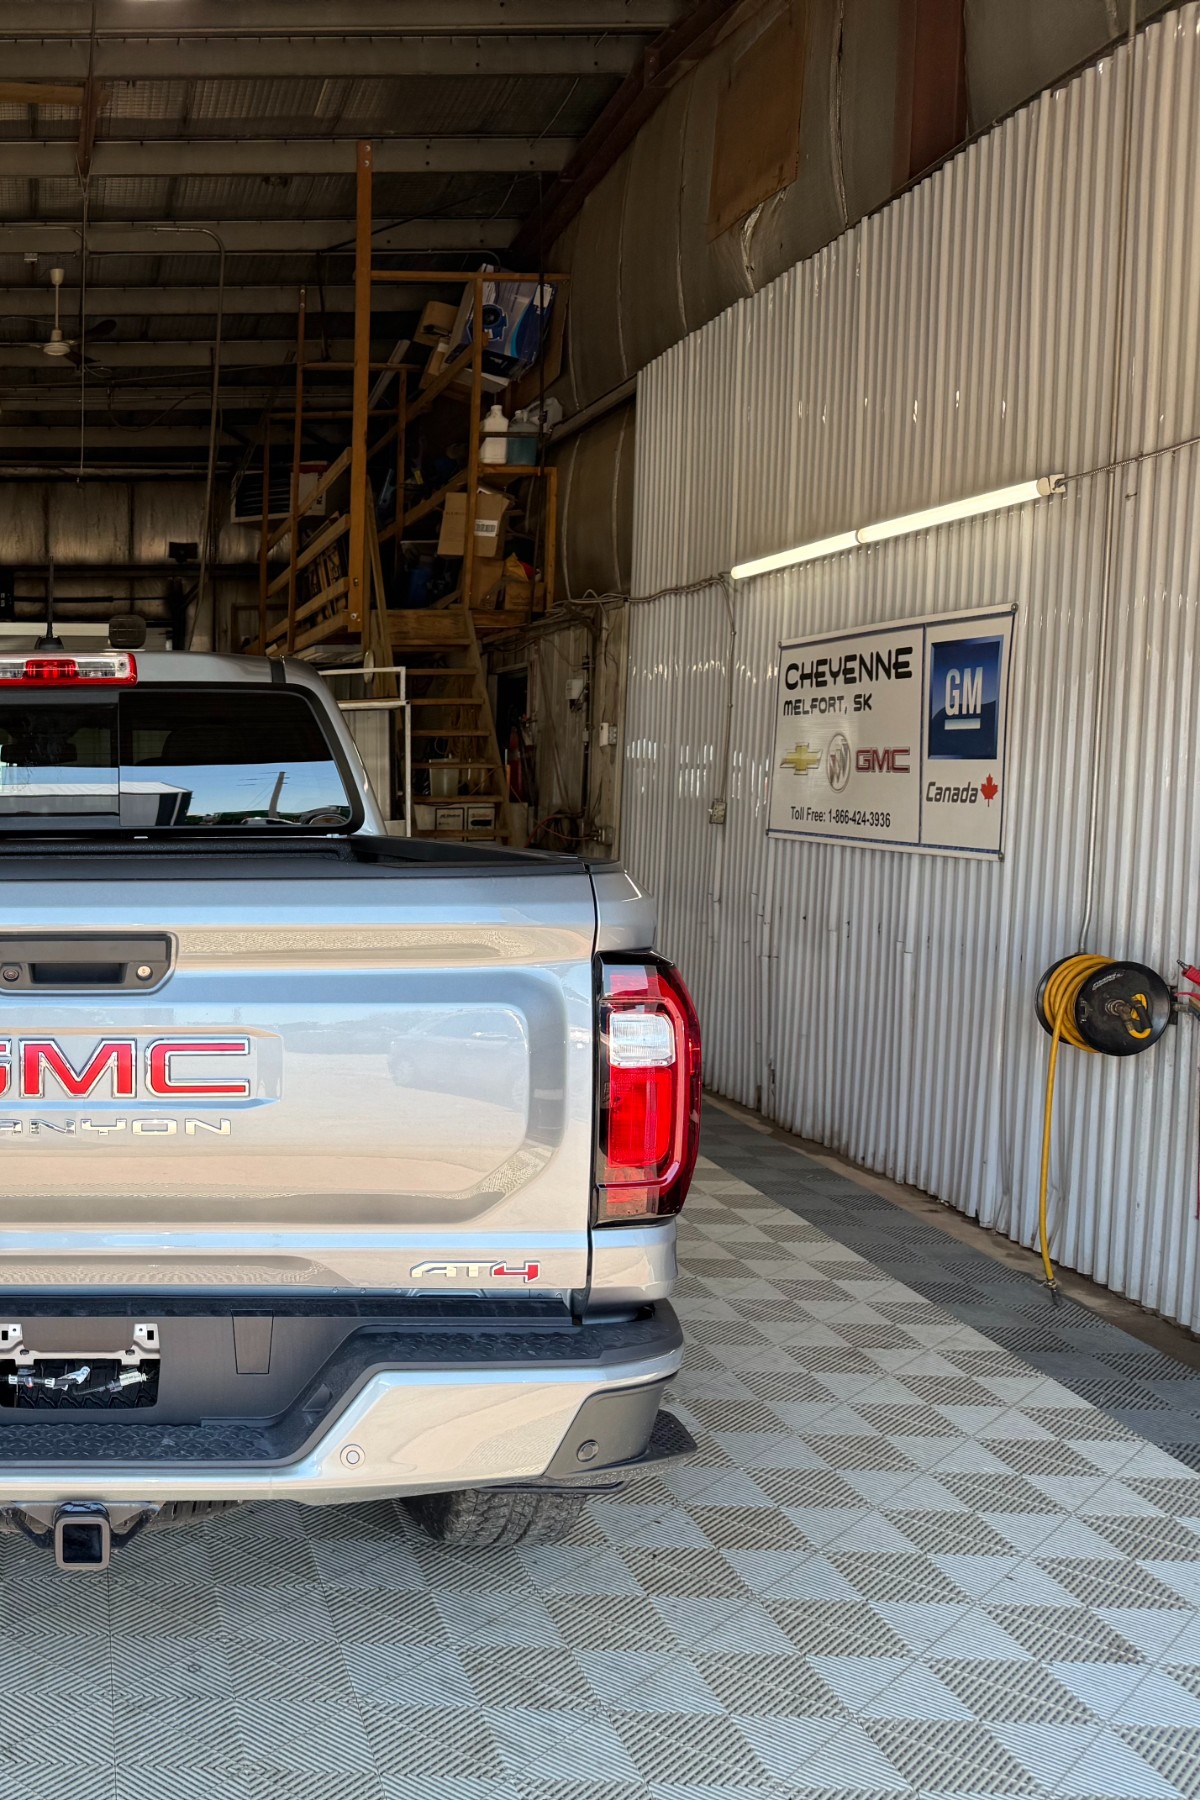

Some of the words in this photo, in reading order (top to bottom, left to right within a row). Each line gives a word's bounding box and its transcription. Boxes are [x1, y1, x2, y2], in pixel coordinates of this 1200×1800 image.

[785, 646, 913, 690] CHEYENNE
[944, 666, 984, 718] GM
[783, 694, 848, 717] MELFORT,
[853, 693, 873, 713] SK
[855, 747, 911, 774] GMC
[926, 781, 978, 804] Canada
[790, 806, 805, 820] Toll
[806, 806, 826, 823] Free:
[828, 808, 891, 828] 1-866-424-3936
[410, 1260, 541, 1283] AT4
